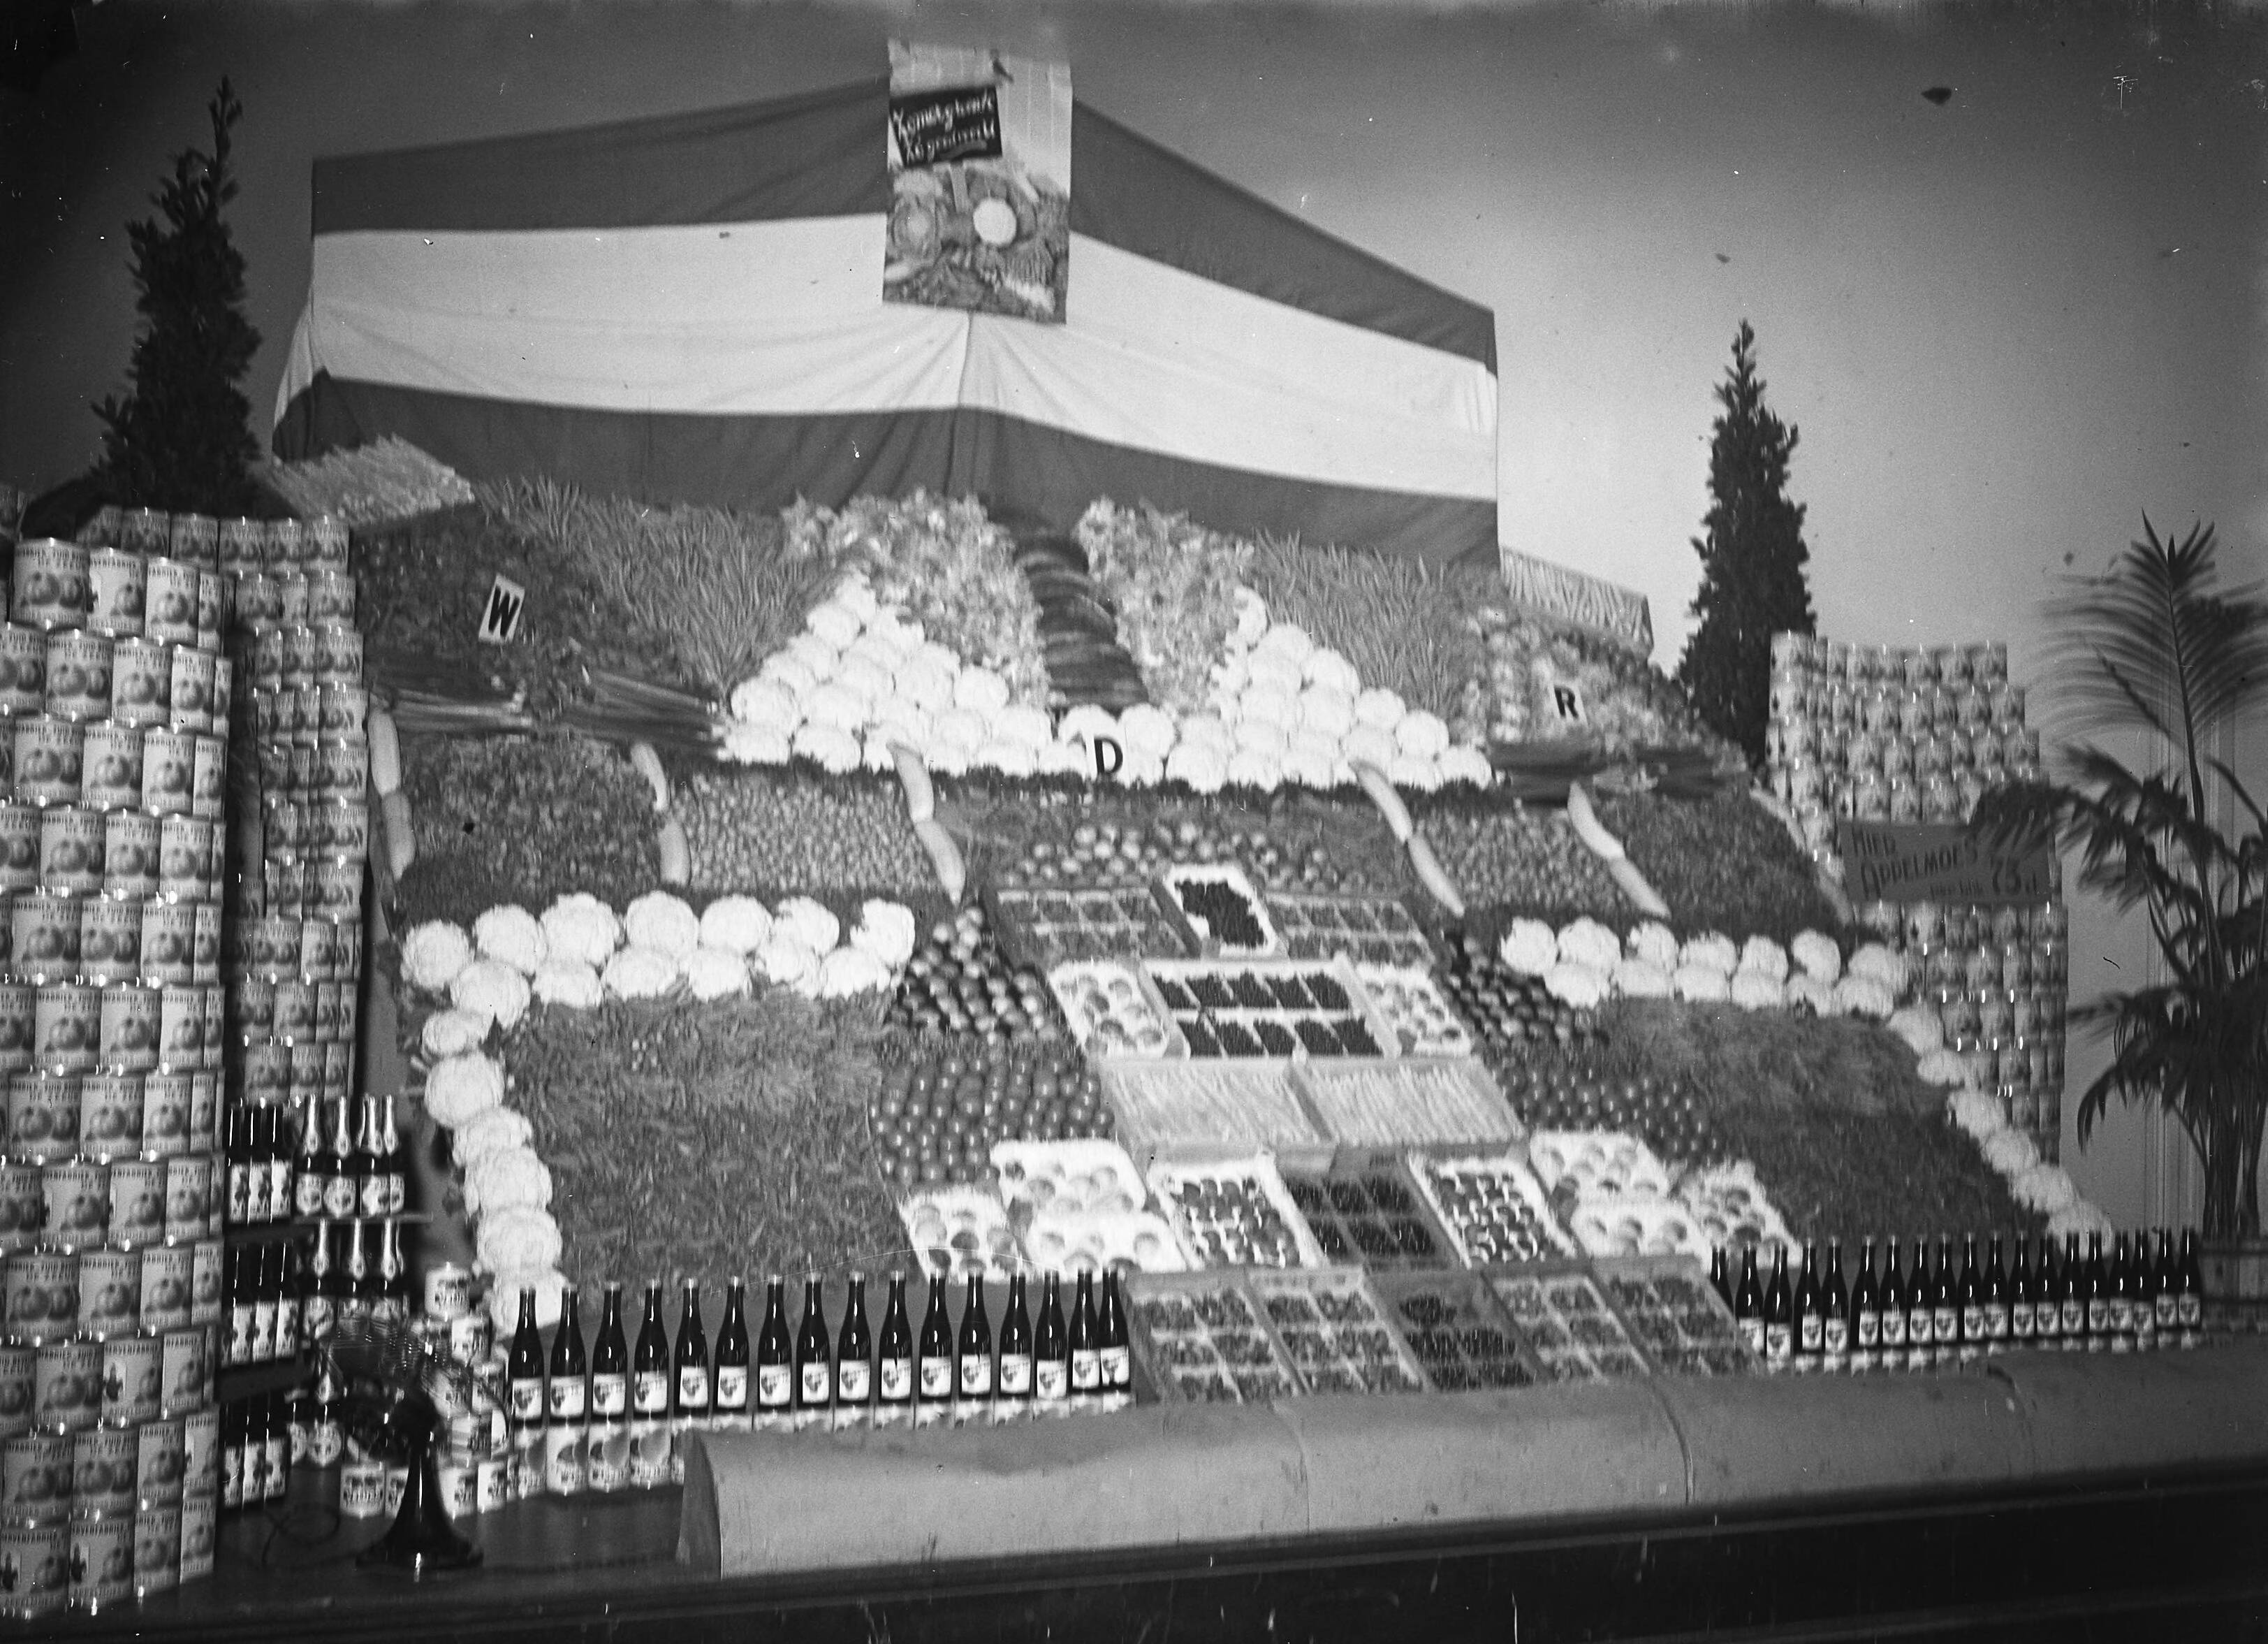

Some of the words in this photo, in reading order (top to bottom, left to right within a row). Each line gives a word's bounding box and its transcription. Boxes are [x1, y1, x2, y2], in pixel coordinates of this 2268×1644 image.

[488, 585, 520, 637] W
[1553, 685, 1579, 718] R
[1094, 736, 1124, 775] D
